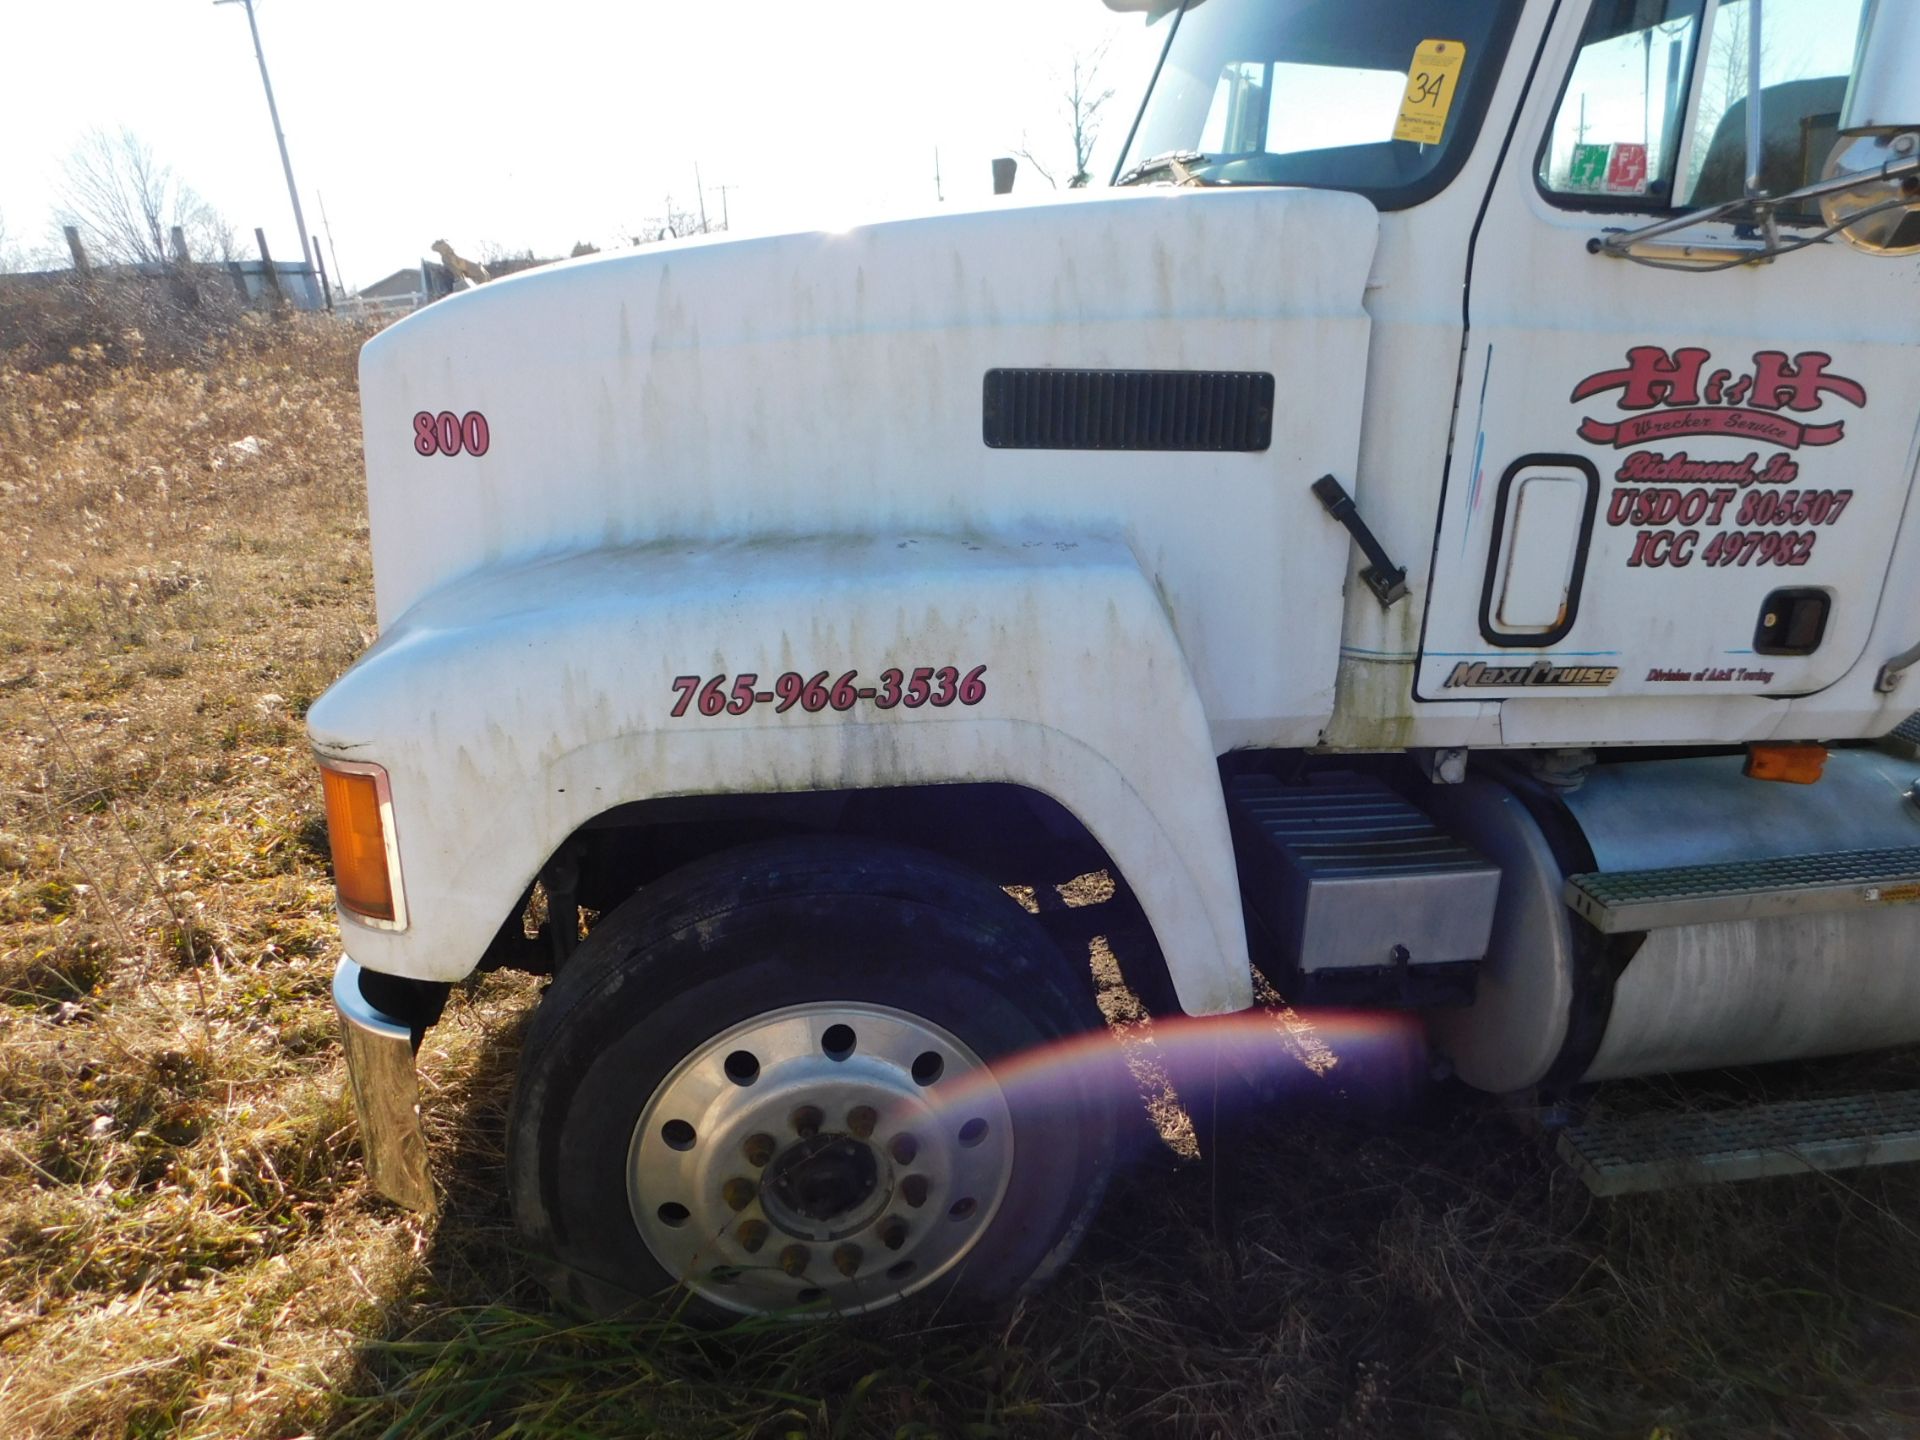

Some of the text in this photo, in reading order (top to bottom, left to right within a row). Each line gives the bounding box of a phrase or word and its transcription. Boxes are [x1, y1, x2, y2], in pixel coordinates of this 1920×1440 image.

[1407, 72, 1445, 108] 34
[413, 410, 490, 457] 800
[1632, 413, 1788, 438] Wrecker Service
[1615, 450, 1758, 488] Richmond,
[1606, 488, 1853, 526] USDOT 805507
[1627, 529, 1816, 567] ICC 497982
[671, 665, 987, 717] 765-966-3536
[1692, 667, 1709, 681] of
